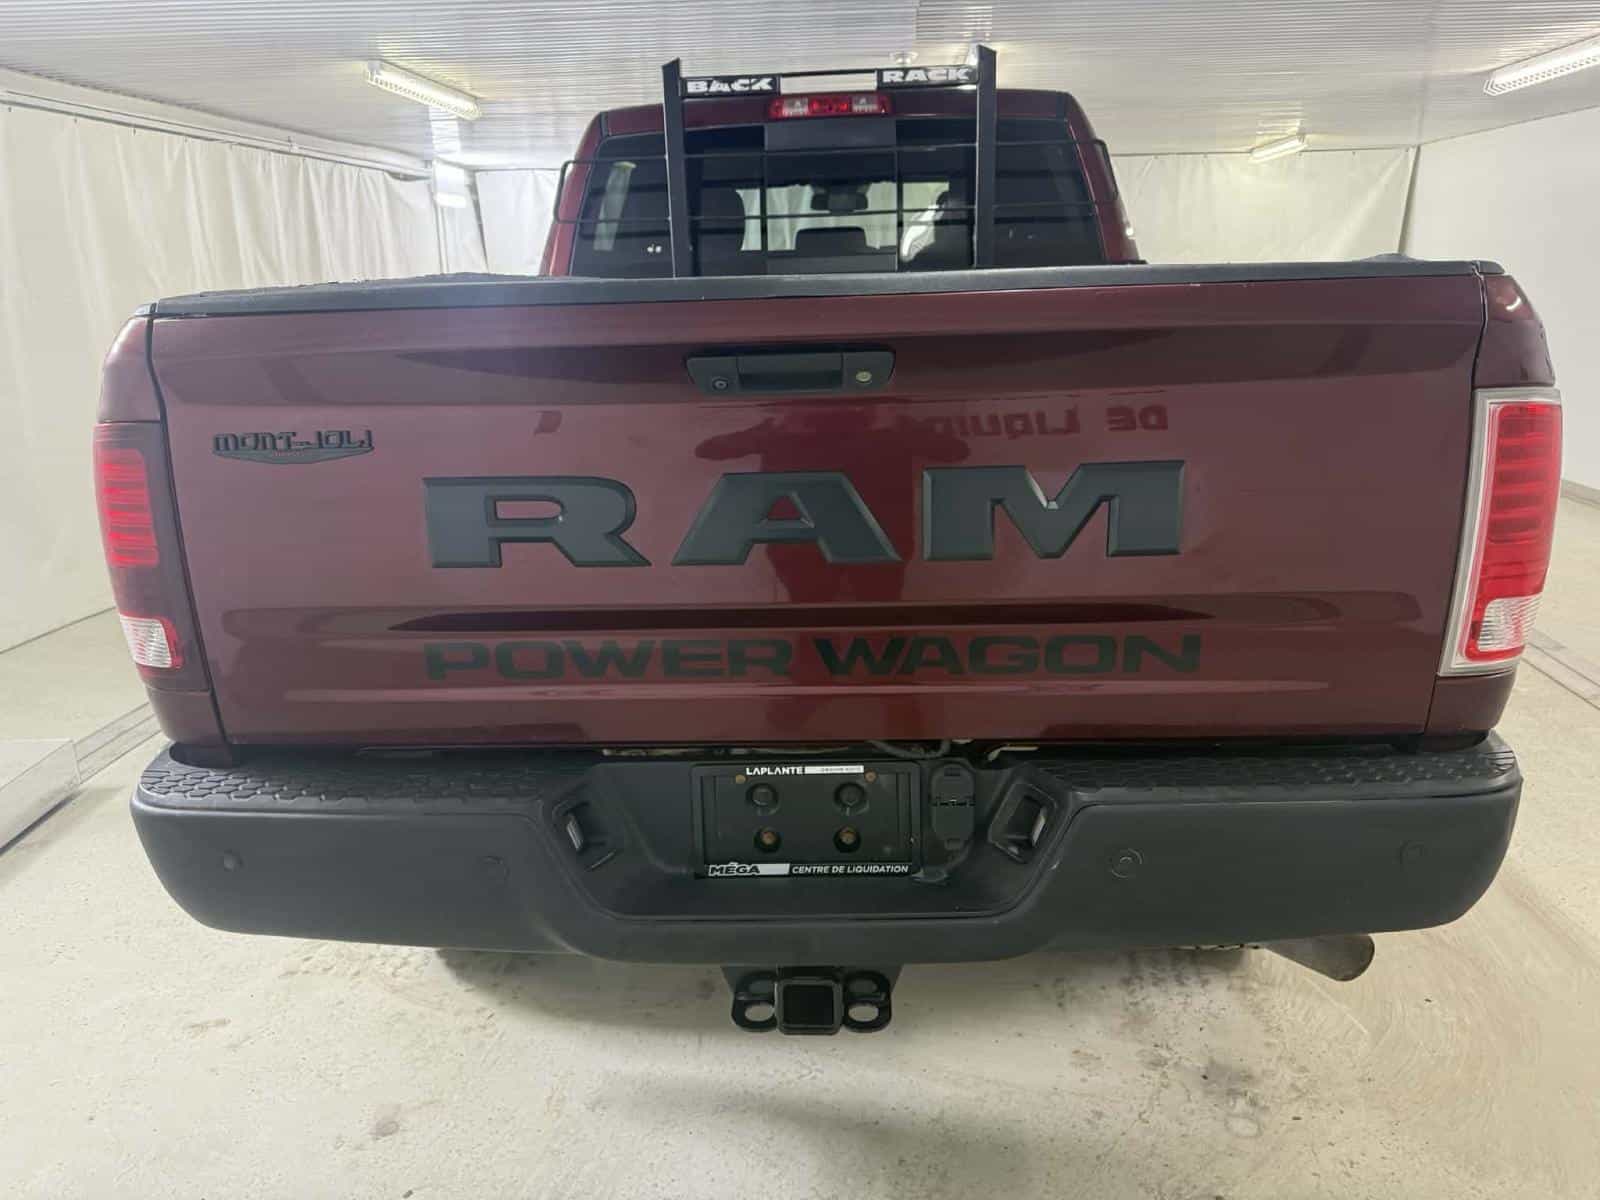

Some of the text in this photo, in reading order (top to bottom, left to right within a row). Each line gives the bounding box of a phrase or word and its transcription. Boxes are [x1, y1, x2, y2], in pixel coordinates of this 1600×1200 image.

[686, 67, 970, 94] BACK RACK
[423, 459, 1186, 568] RAM
[423, 633, 1201, 681] POWER WAGON
[745, 766, 804, 776] LAPLANTE
[708, 862, 909, 877] MÉGA CENTRE DE LIQUIDATION
